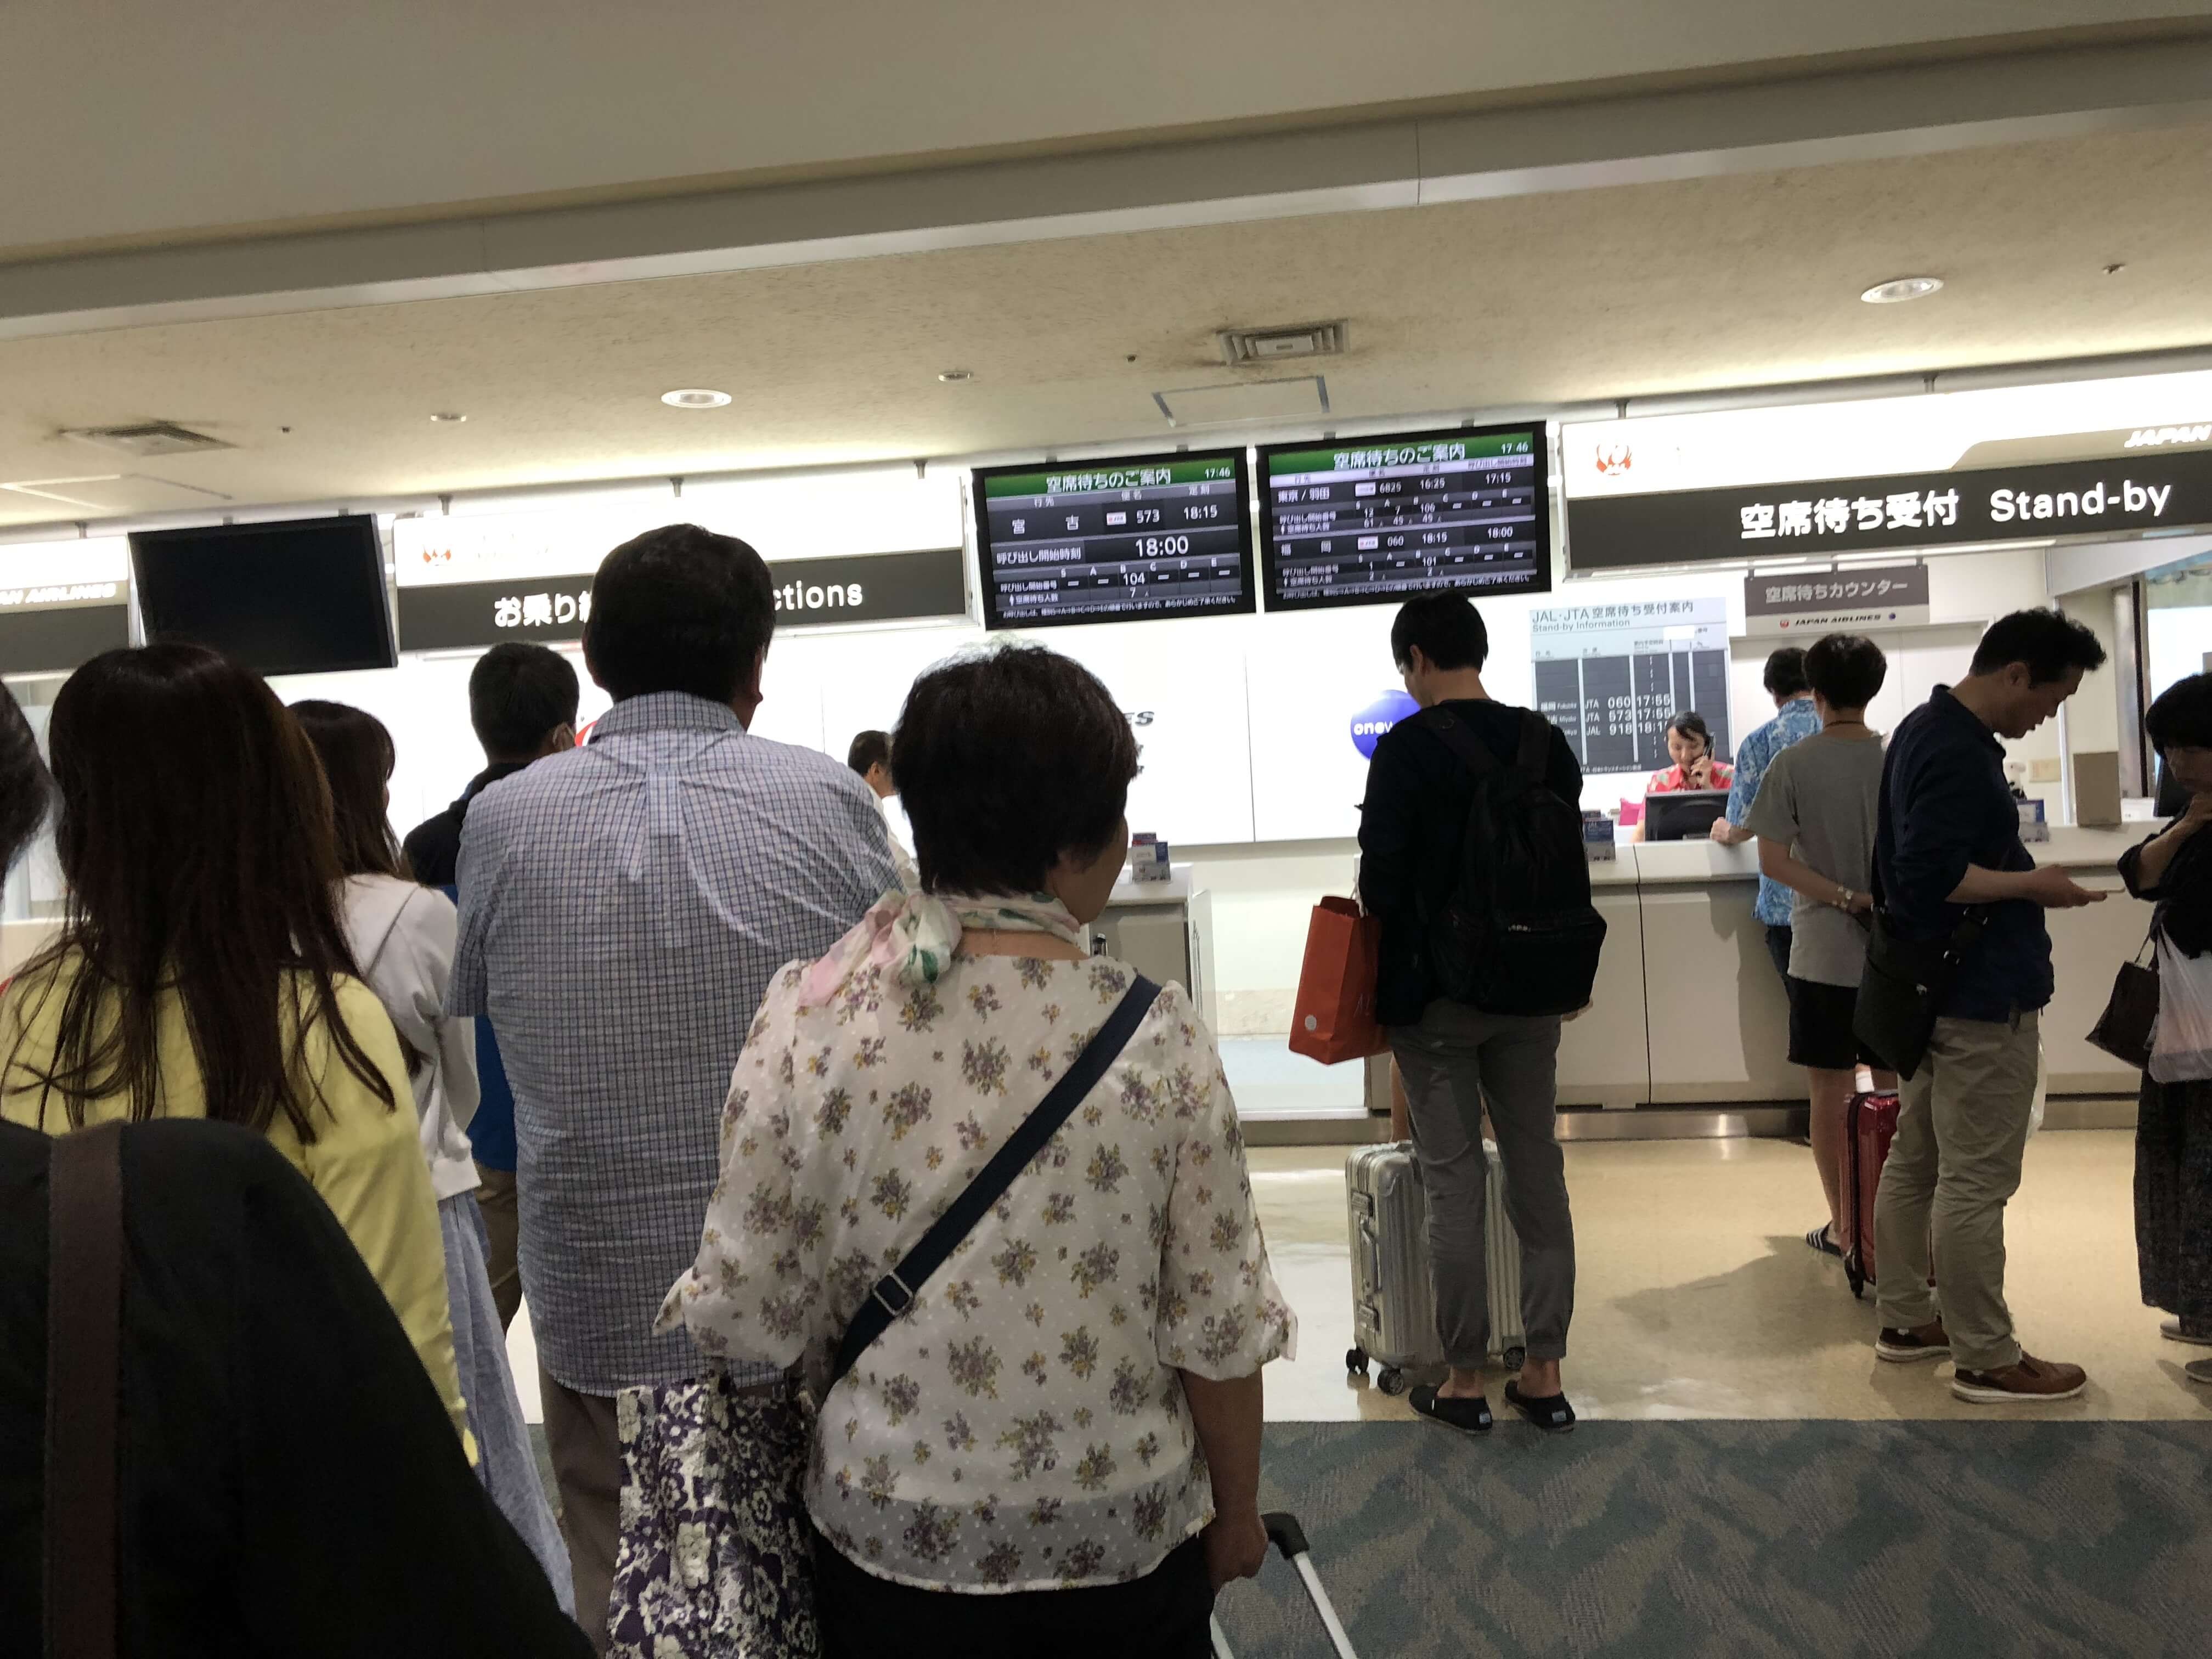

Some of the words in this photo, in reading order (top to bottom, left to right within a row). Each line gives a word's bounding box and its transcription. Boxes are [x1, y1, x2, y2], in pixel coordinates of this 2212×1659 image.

[1334, 442, 1465, 470] 空席待ちのご案内
[1046, 467, 1171, 493] 空席待ちのご案内
[1136, 509, 1160, 524] 573
[1184, 505, 1217, 520] 18:15
[1741, 489, 1959, 539] 空席待ち受付
[1990, 479, 2171, 523] Stand-by
[1136, 535, 1188, 557] 18:00
[1124, 572, 1145, 585] 104
[1130, 587, 1136, 598] 7
[1765, 579, 1908, 604] 空席待ちカウンター
[1592, 600, 1694, 619] 空席待ち受付案内
[1533, 620, 1573, 633] Stand-by
[1577, 619, 1630, 629] Information
[1795, 617, 1827, 626] JAPAN
[1830, 614, 1881, 624] AIRLINES
[1585, 698, 1599, 709] JTA
[1608, 696, 1631, 709] 060
[1585, 712, 1600, 723] JTA
[1586, 724, 1601, 736] JAL
[1610, 721, 1633, 736] 918
